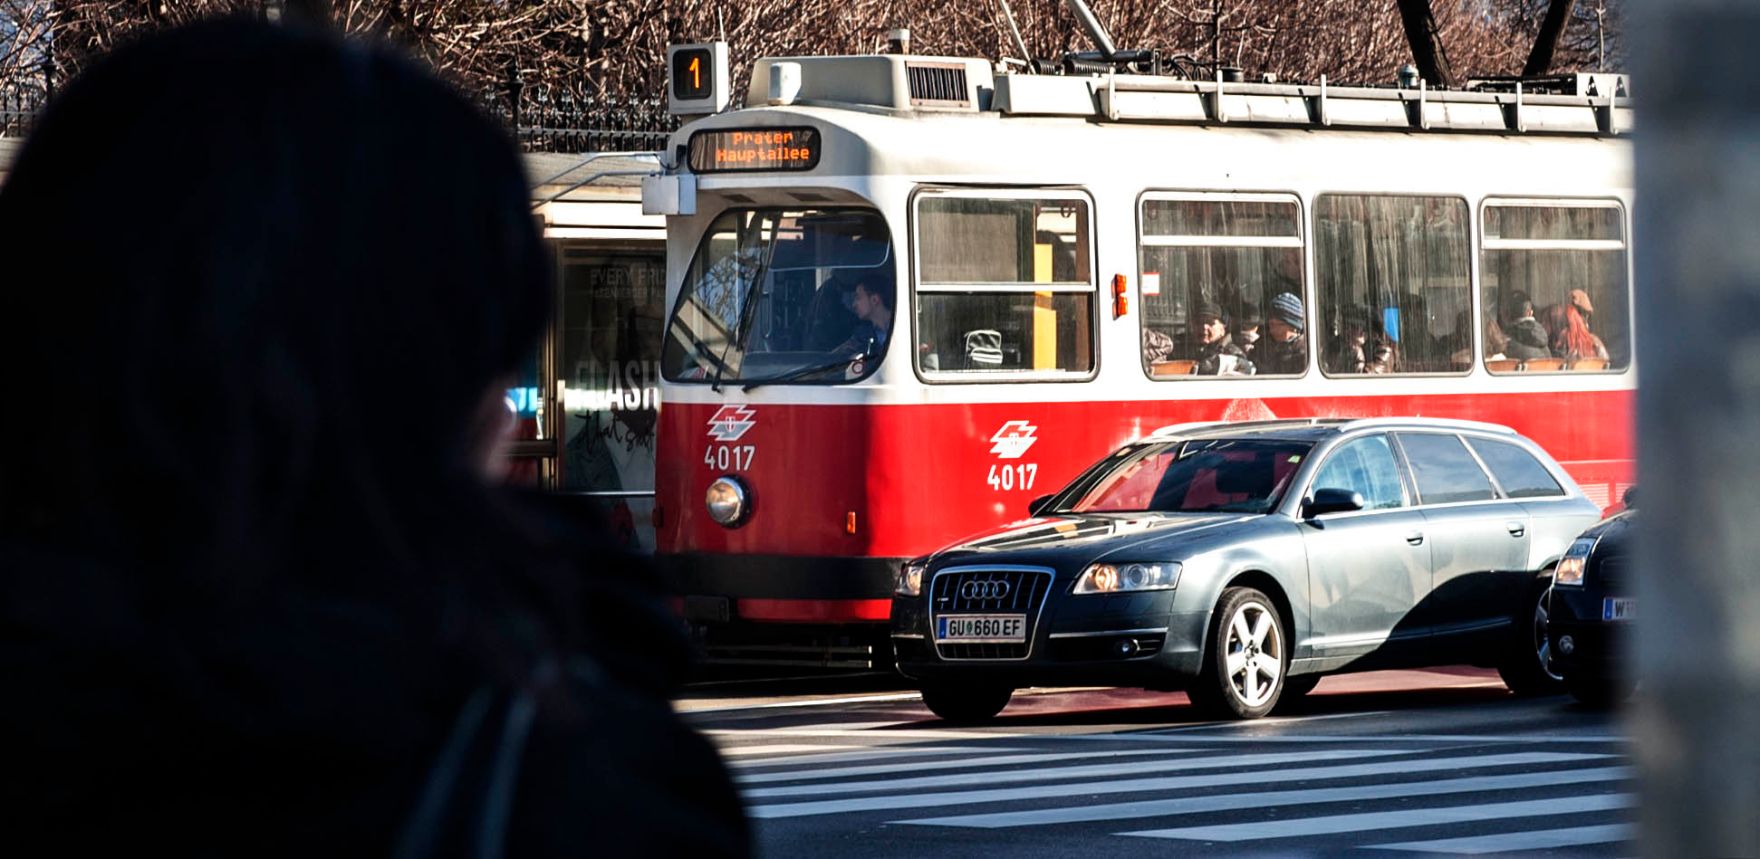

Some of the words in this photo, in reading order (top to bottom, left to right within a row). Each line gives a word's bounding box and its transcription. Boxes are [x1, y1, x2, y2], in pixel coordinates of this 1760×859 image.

[689, 57, 699, 89] 1
[733, 131, 793, 144] Prater
[716, 147, 809, 162] Hauptallee
[590, 268, 633, 285] EVERY
[704, 445, 755, 472] 4017
[987, 463, 1038, 491] 4017
[949, 620, 965, 636] GU
[974, 619, 1000, 636] 660
[1003, 619, 1020, 636] EF
